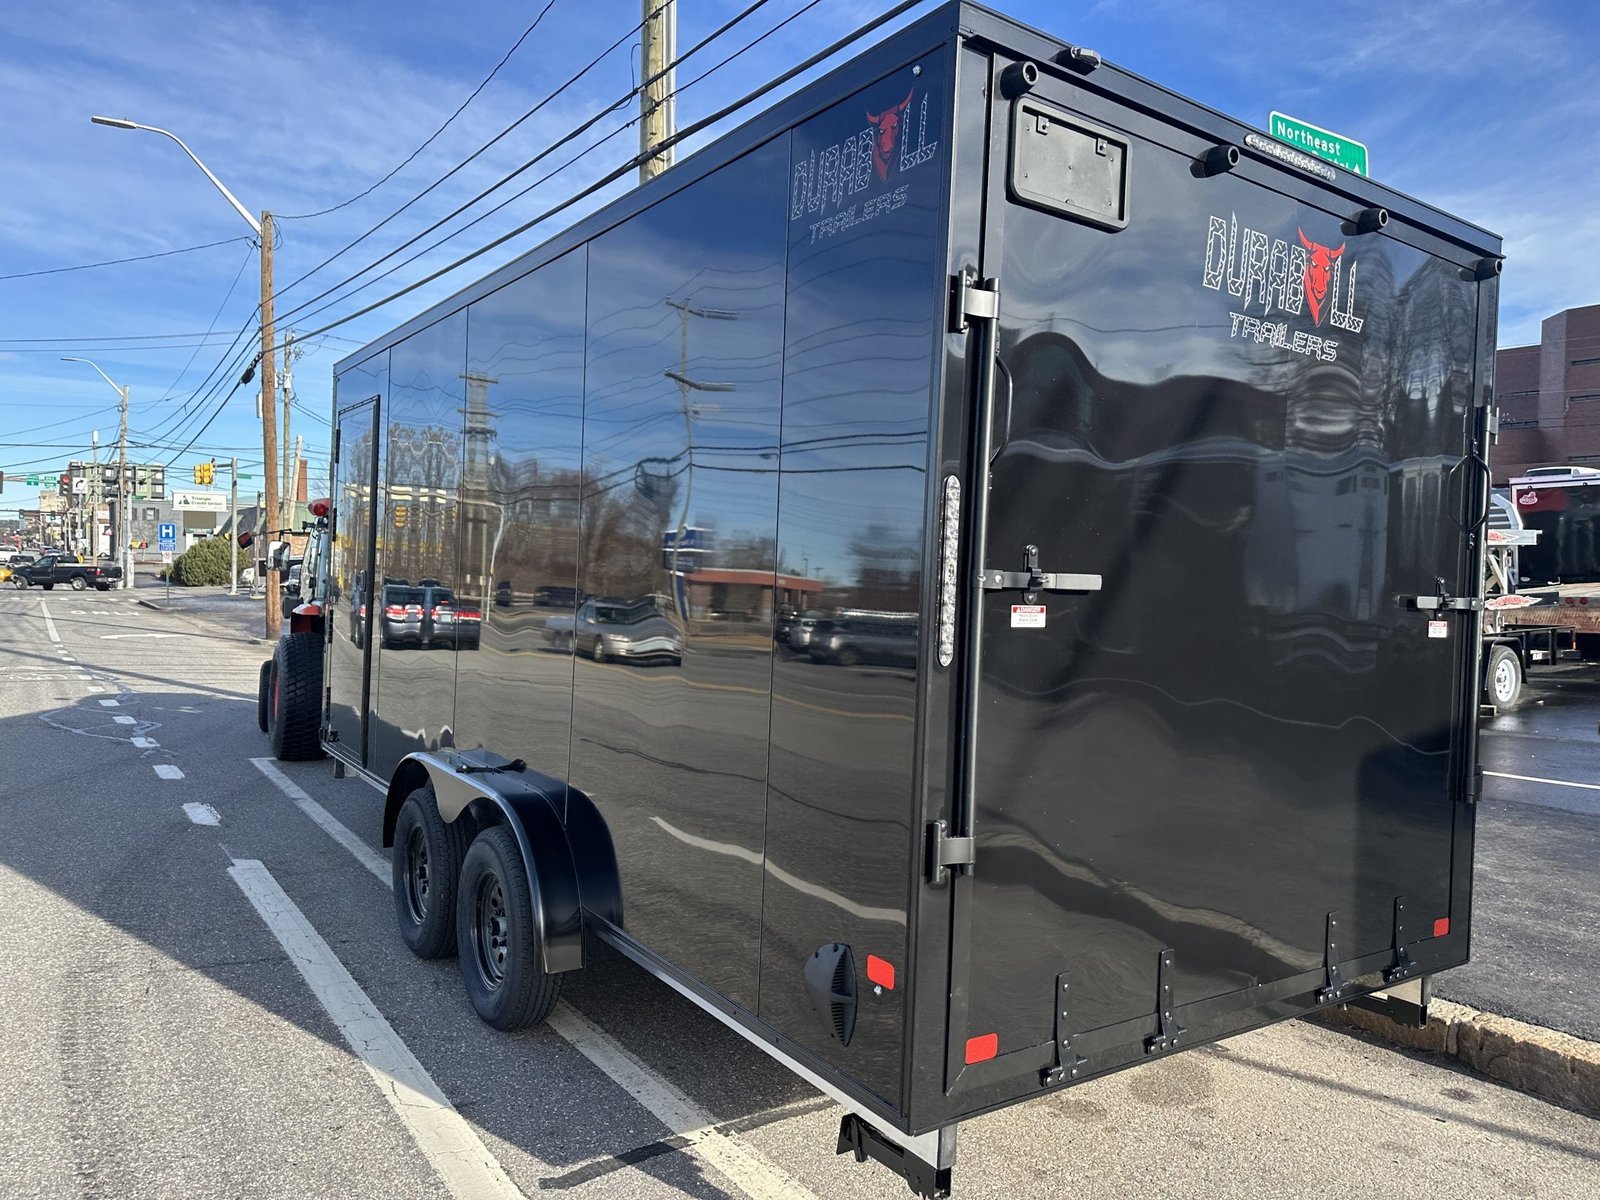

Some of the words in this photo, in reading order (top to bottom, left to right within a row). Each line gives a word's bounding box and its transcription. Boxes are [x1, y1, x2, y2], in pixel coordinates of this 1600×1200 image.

[1277, 120, 1341, 156] Northeast
[809, 184, 909, 245] TRAILERS
[1230, 311, 1339, 362] TRAILERS
[161, 525, 173, 538] H
